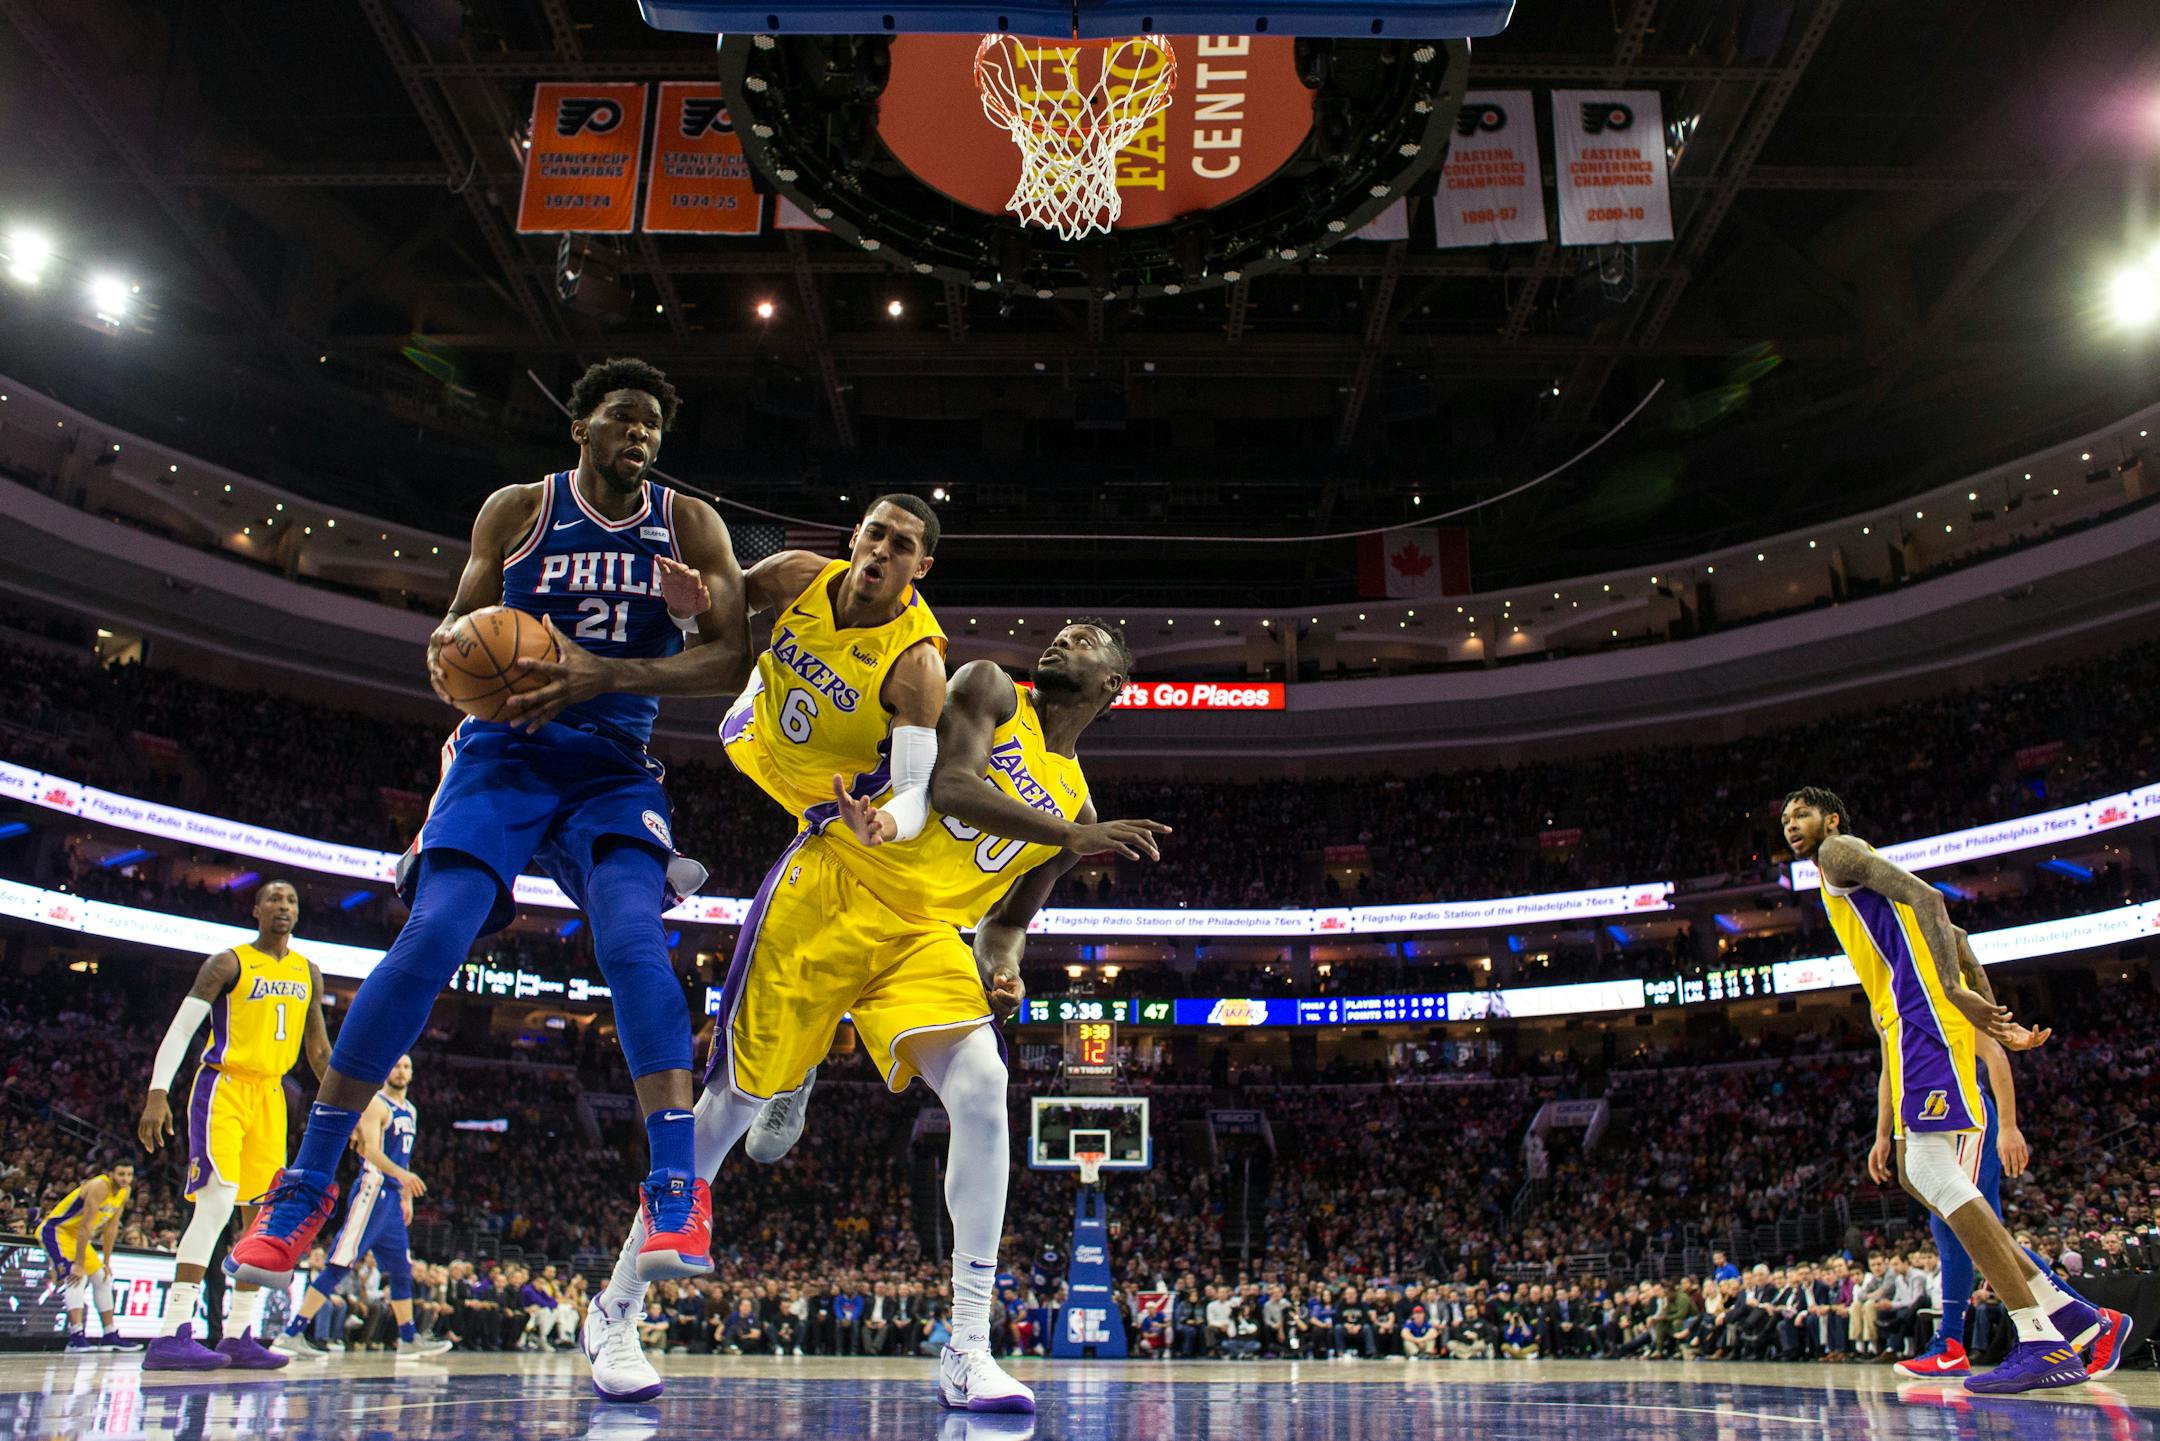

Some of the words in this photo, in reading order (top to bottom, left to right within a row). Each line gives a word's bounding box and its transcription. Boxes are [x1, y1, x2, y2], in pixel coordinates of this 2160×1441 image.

[539, 152, 598, 165] STANLEY
[603, 152, 629, 163] CUP
[662, 152, 722, 165] STANLEY
[1454, 148, 1514, 161] EASTERN
[1581, 148, 1641, 160] EASTERN
[541, 166, 624, 177] CHAMPIONS
[665, 166, 750, 178] CHAMPIONS
[1444, 161, 1526, 176] CONFERENCE
[1570, 161, 1653, 173] CONFERENCE
[1446, 175, 1525, 190] CHAMPIONS
[1574, 173, 1653, 186] CHAMPIONS
[546, 194, 612, 208] 1973-74
[671, 194, 737, 209] 1974-75
[642, 528, 668, 539] StubHub
[575, 598, 630, 643] 21
[852, 645, 878, 669] wish
[771, 626, 861, 713] LAKERS
[1154, 683, 1189, 706] Go
[1191, 683, 1270, 707] Places
[778, 687, 819, 745] 6
[92, 799, 144, 822] Flagship
[146, 812, 182, 830] Radio
[185, 820, 227, 840] Station
[230, 830, 243, 842] of
[244, 833, 262, 847] the
[265, 838, 333, 864] Philadelphia
[336, 853, 367, 868] 76ers
[1930, 845, 1942, 857] of
[1945, 841, 1963, 854] the
[1965, 826, 2039, 850] Philadelphia
[2043, 817, 2077, 833] 76ers
[1362, 912, 1407, 926] Flagship
[1409, 910, 1440, 922] Radio
[1443, 909, 1481, 920] Station
[1484, 907, 1497, 918] of
[1498, 906, 1514, 917] the
[1516, 899, 1582, 916] Philadelphia
[1585, 896, 1615, 908] 76ers
[1055, 915, 1100, 927] Flagship
[1102, 916, 1133, 926] Radio
[1136, 916, 1172, 927] Station
[1174, 916, 1186, 927] of
[1188, 916, 1204, 927] the
[1207, 916, 1271, 929] Philadelphia
[1274, 917, 1302, 927] 76ers
[247, 977, 307, 1001] LAKERS
[1059, 1002, 1103, 1020] 3:38
[1144, 1003, 1169, 1020] 47
[1328, 1000, 1338, 1010] 4
[1346, 999, 1382, 1010] PLAYER
[1030, 1008, 1049, 1021] 13
[1114, 1009, 1126, 1021] 2
[1346, 1010, 1382, 1020] POINTS
[275, 1003, 287, 1041] 1
[1080, 1023, 1111, 1040] 3:38
[1084, 1039, 1106, 1064] 12
[1079, 1066, 1114, 1075] TISSOT
[672, 1181, 683, 1191] 21
